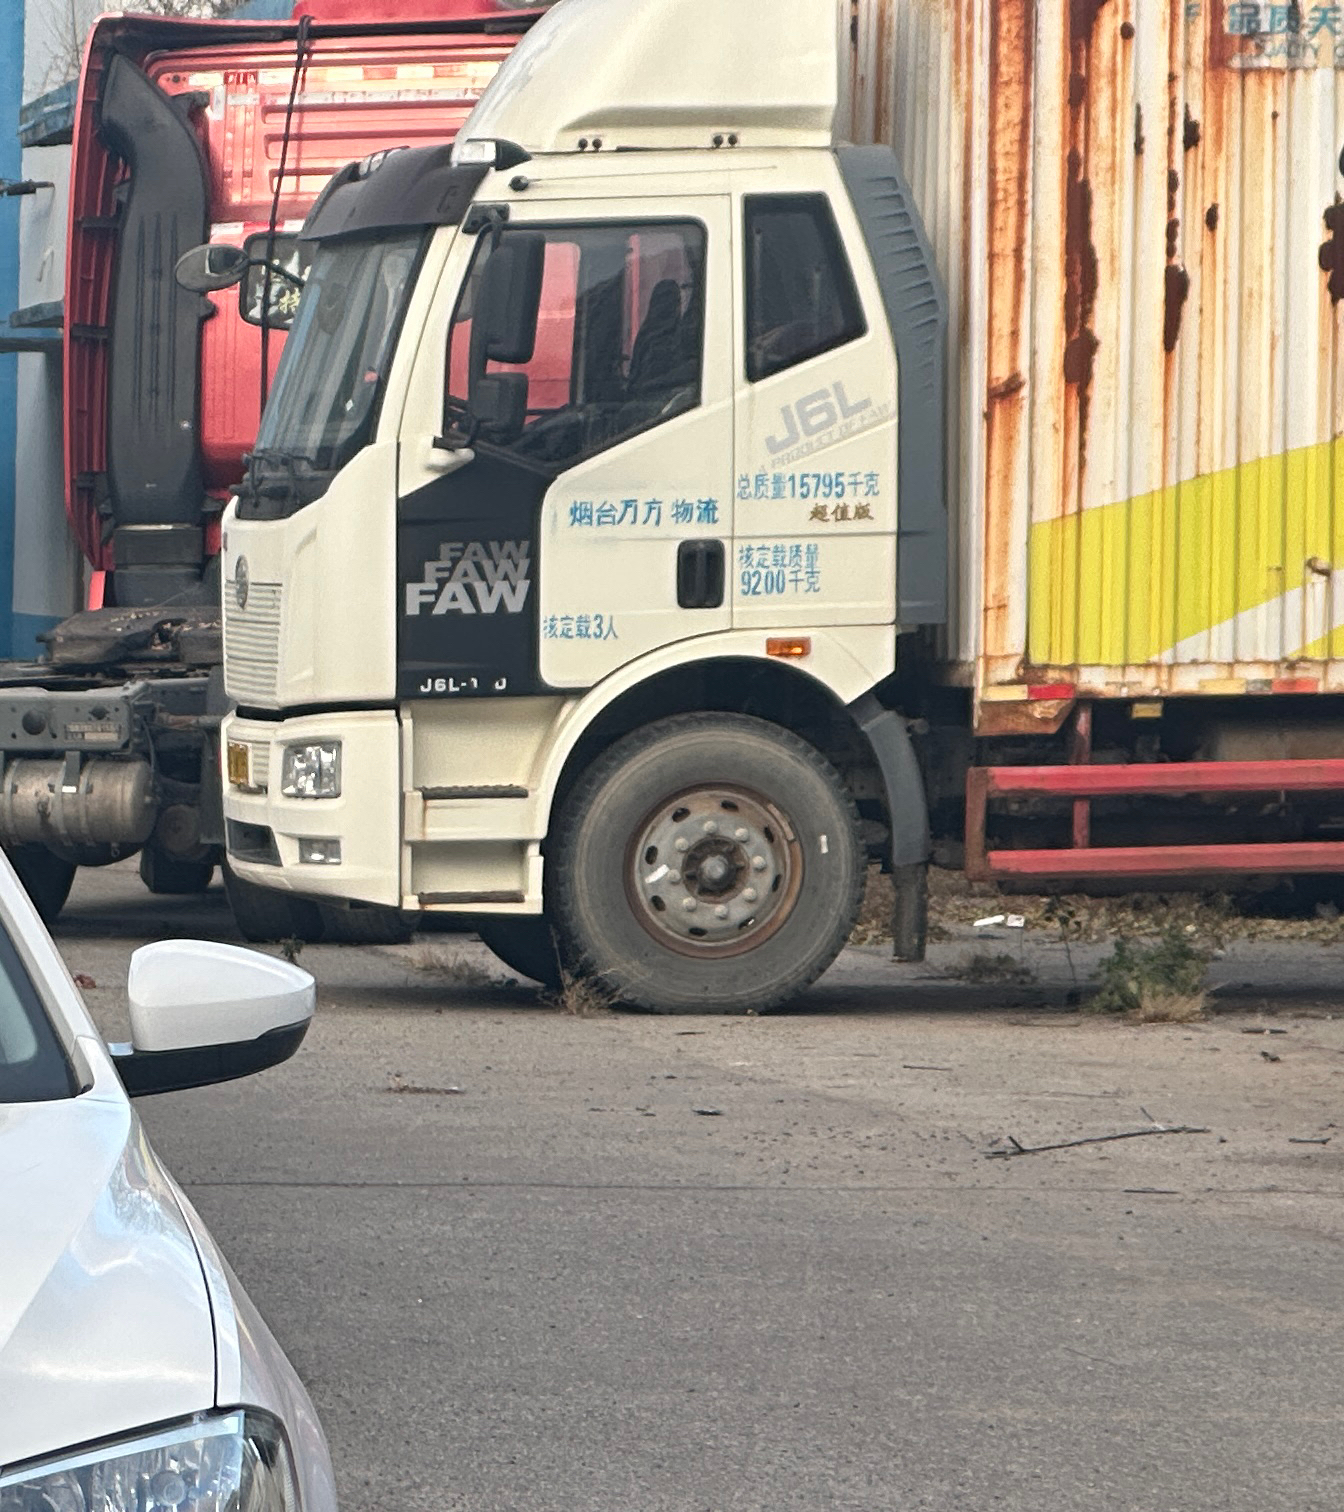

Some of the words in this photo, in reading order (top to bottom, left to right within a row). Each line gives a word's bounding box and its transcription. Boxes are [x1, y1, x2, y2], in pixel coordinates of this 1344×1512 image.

[765, 380, 872, 455] J6L
[424, 558, 530, 584] FAW
[741, 569, 821, 596] 9200千克
[405, 579, 530, 616] FAW
